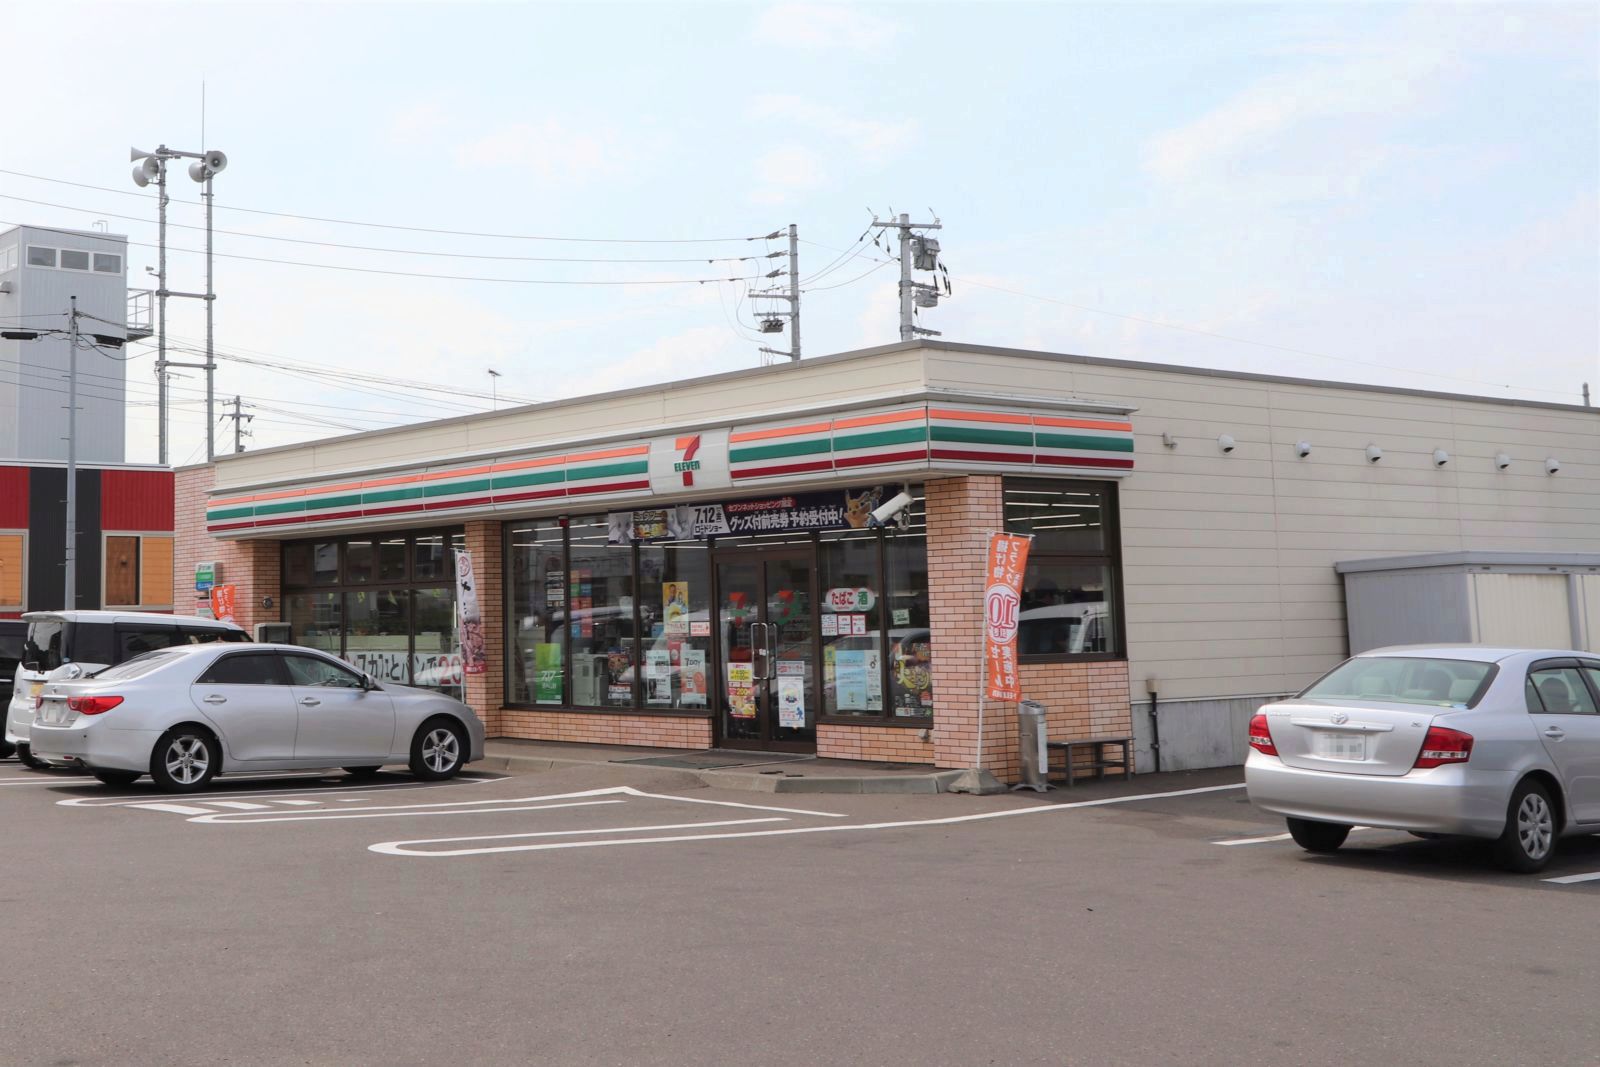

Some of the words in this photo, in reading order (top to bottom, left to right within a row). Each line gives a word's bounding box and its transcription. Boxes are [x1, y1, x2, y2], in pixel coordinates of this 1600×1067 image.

[831, 591, 854, 605] たばこ
[857, 591, 868, 605] 酒
